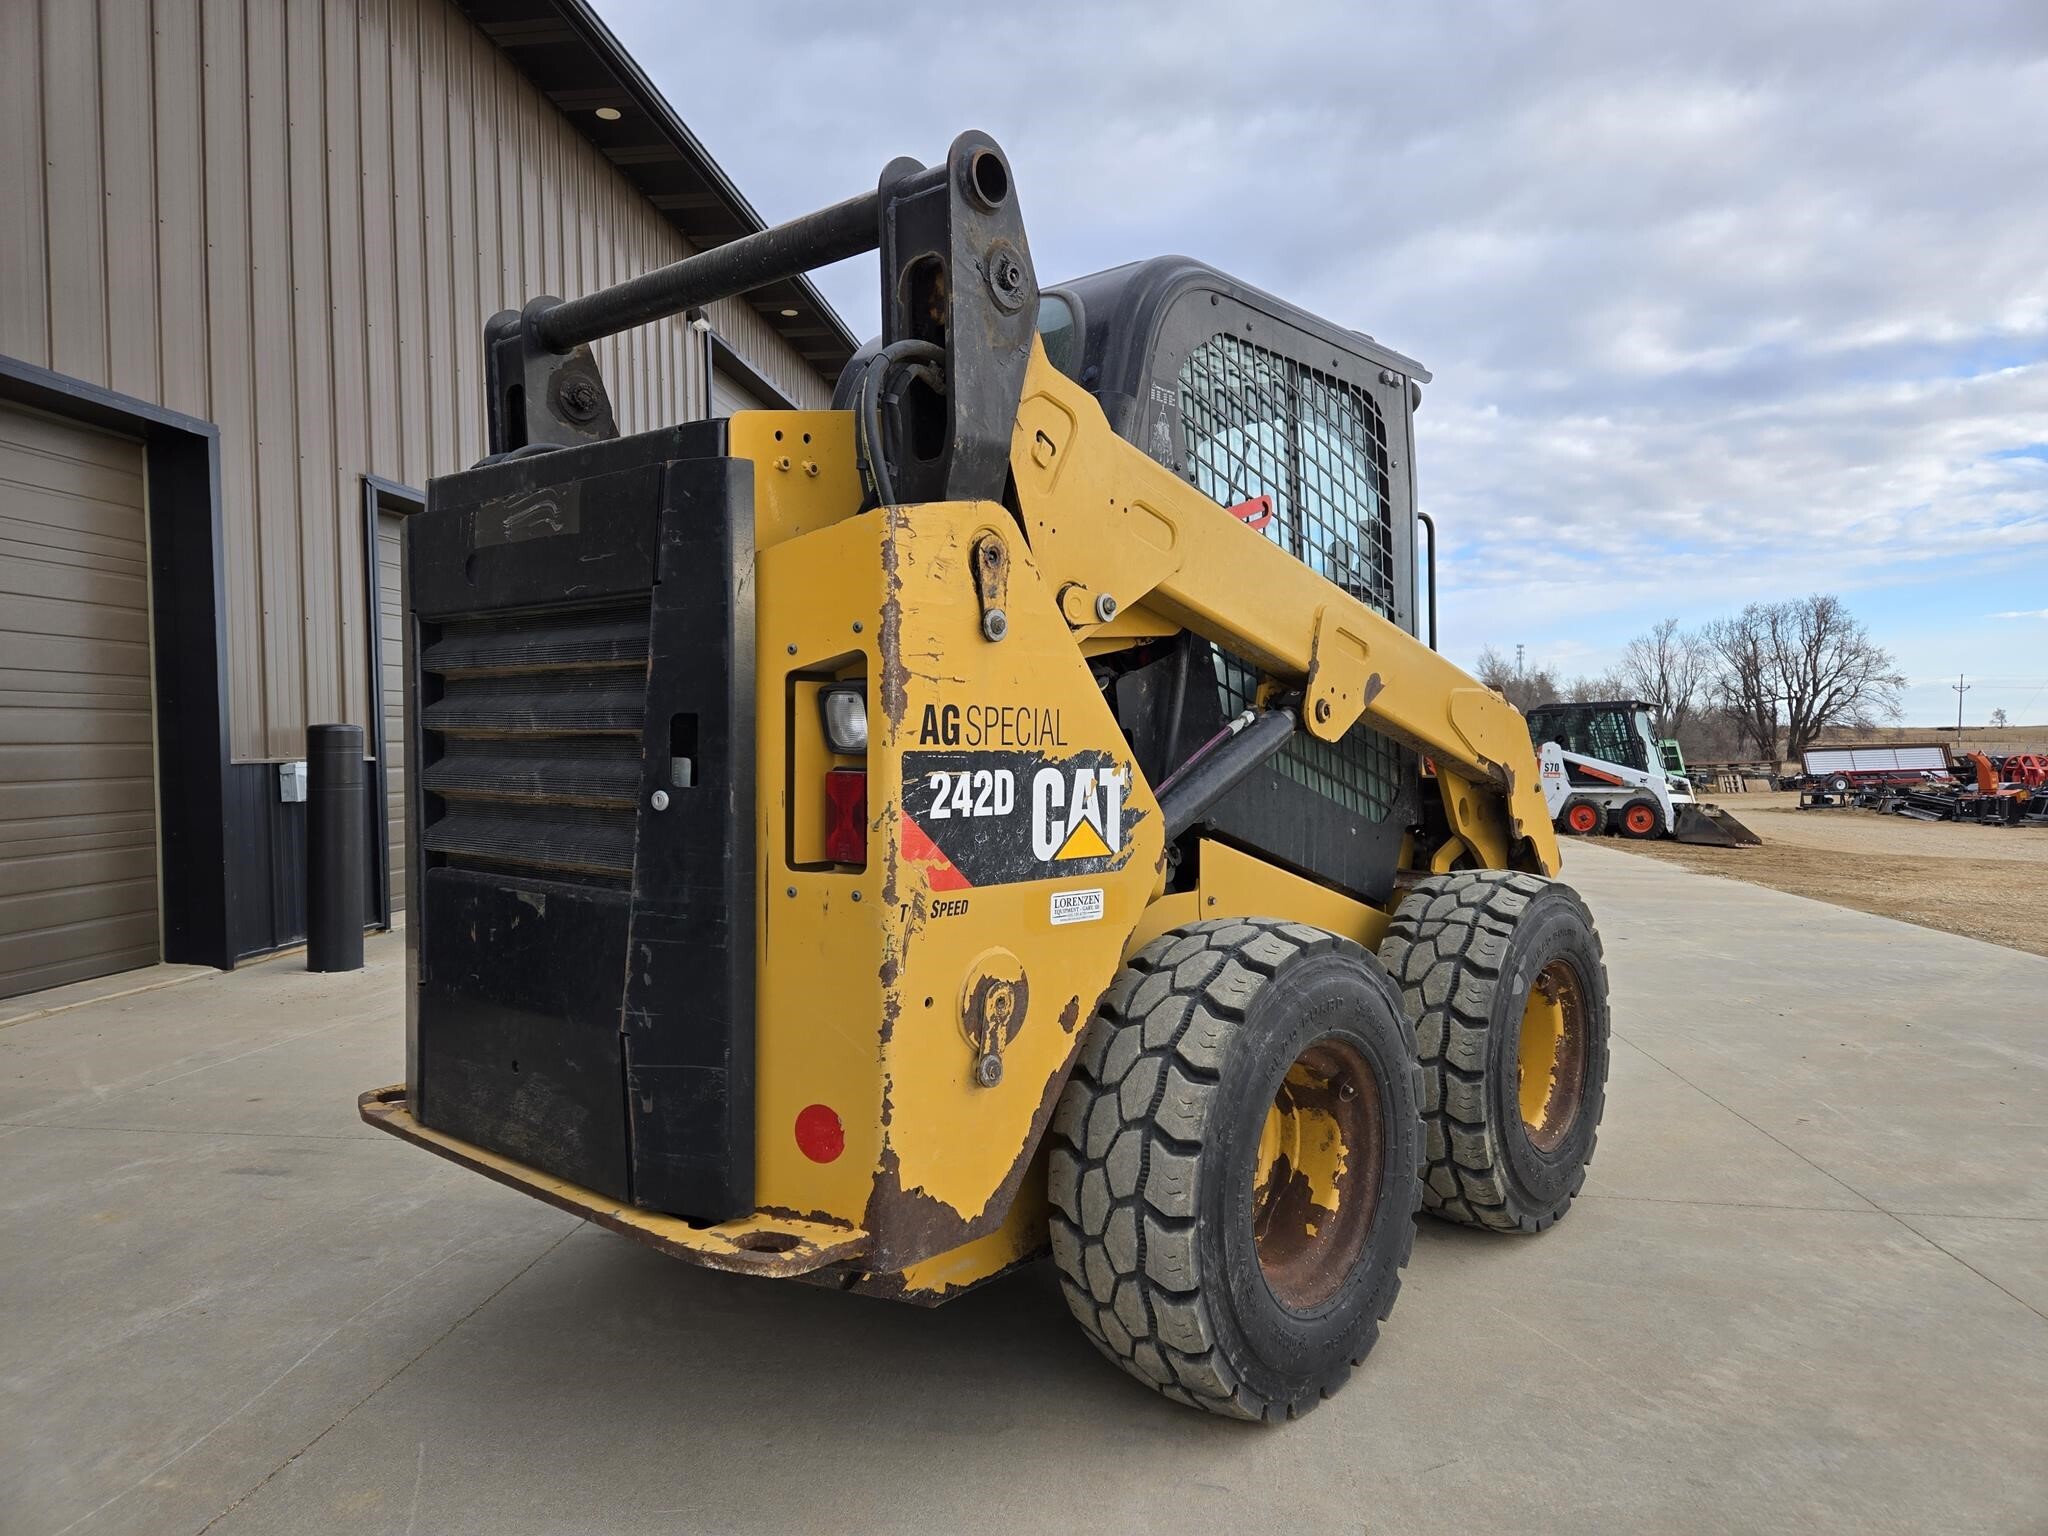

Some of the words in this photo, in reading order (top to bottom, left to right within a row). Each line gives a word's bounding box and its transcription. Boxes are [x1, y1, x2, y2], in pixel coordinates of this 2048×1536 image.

[919, 703, 961, 746] AG
[966, 704, 1068, 747] SPECIAL
[1544, 762, 1560, 772] S70
[929, 768, 1015, 820] 242D
[1032, 767, 1128, 862] CAT
[1054, 894, 1100, 909] LORENZEN
[1054, 906, 1080, 916] EQUIPMENT
